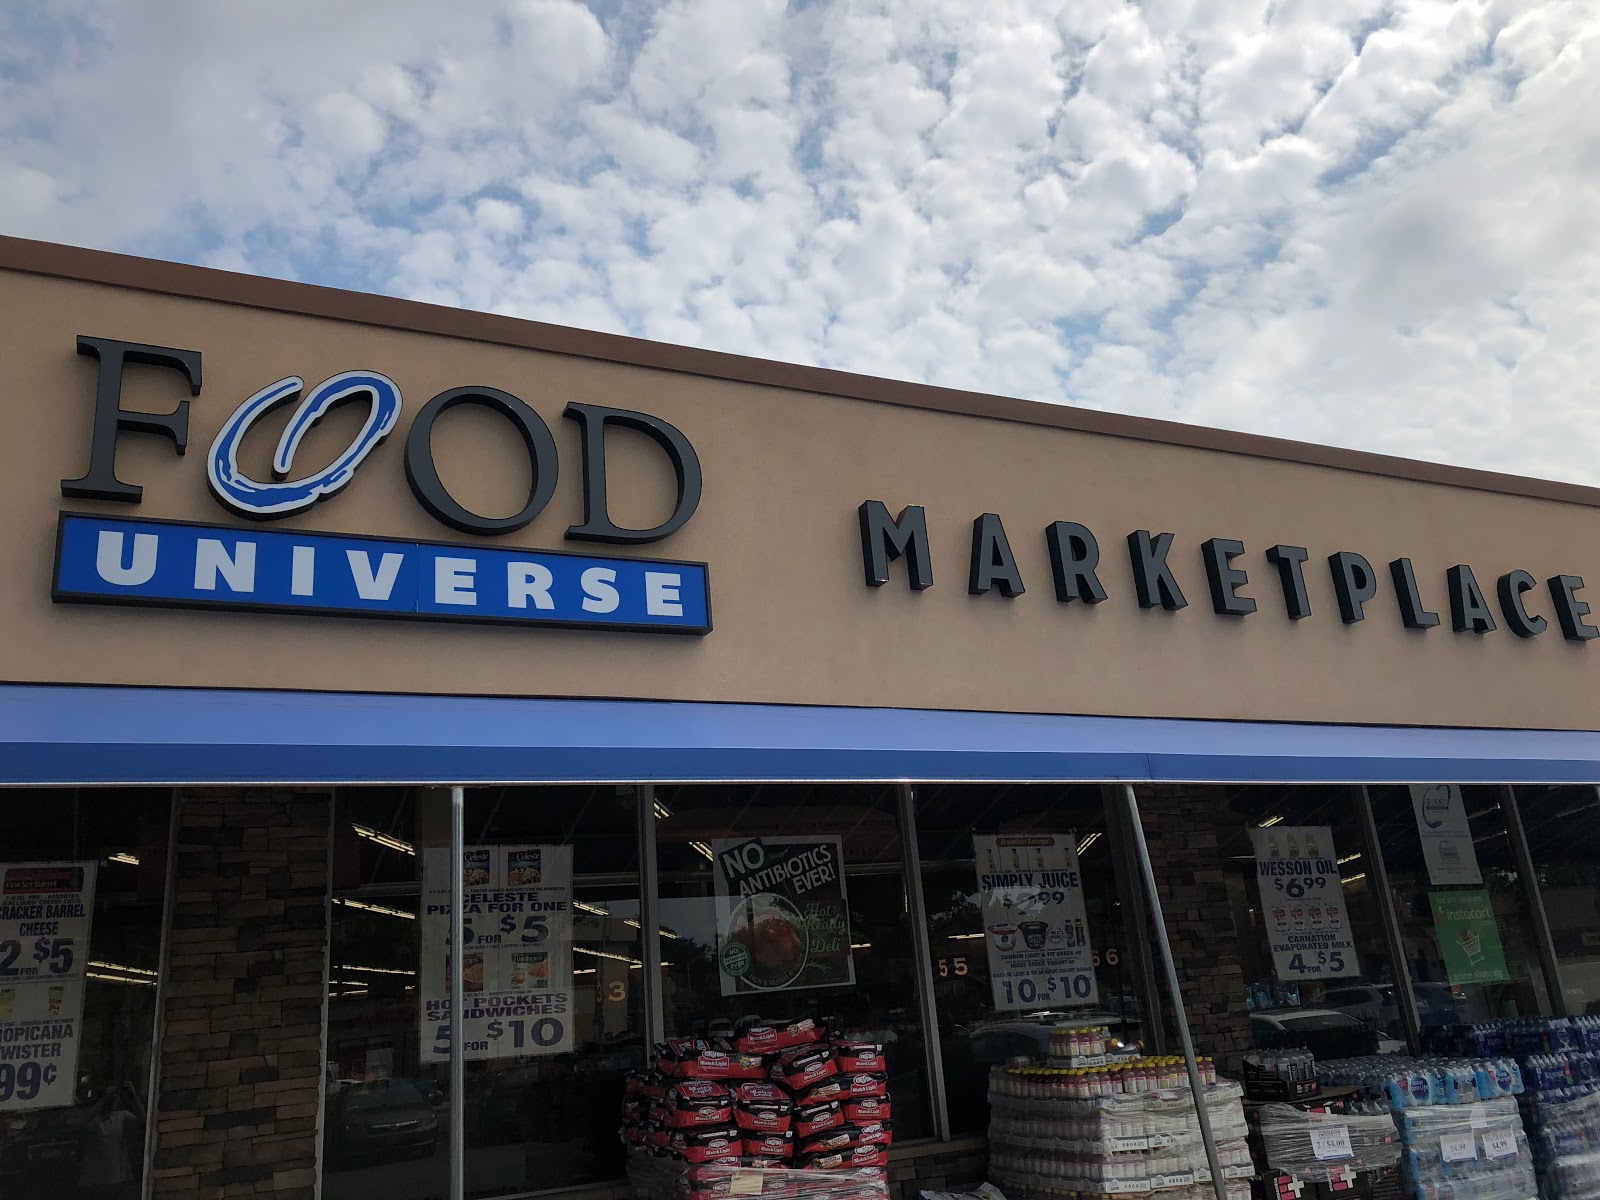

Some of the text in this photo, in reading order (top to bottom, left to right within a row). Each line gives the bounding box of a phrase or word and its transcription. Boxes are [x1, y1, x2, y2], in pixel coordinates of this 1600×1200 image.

[60, 334, 703, 546] FOOD
[96, 530, 685, 617] UNIVERSE
[858, 500, 1600, 641] MARKETPLACE
[464, 852, 489, 861] Celeste
[515, 851, 541, 861] Celeste
[722, 842, 765, 879] NO
[739, 844, 832, 898] ANTIBIOTICS
[1259, 859, 1338, 877] WESSON OIL
[793, 862, 837, 895] EVER!
[981, 871, 1079, 891] SIMPLY JUICE
[463, 892, 539, 904] CELESTE
[487, 902, 524, 914] FOR
[530, 901, 568, 912] ONE
[46, 904, 86, 919] BARREL
[1446, 907, 1492, 921] instacart
[20, 922, 59, 937] CHEESE
[478, 934, 502, 944] FOR
[500, 913, 550, 943] $5
[811, 937, 841, 953] Deli
[1273, 940, 1353, 953] EVAPORATED MILK
[1287, 933, 1337, 944] CARNATION
[0, 937, 74, 976] 2 FOR $5
[729, 948, 739, 956] NO
[1288, 950, 1345, 974] 4 FOR $5
[608, 981, 626, 1002] 3
[1002, 974, 1092, 1004] 10 FOR $10
[426, 992, 569, 1011] HO POCKETS
[464, 1041, 489, 1051] FOR
[486, 1018, 564, 1049] $10
[0, 1043, 62, 1061] WISTER
